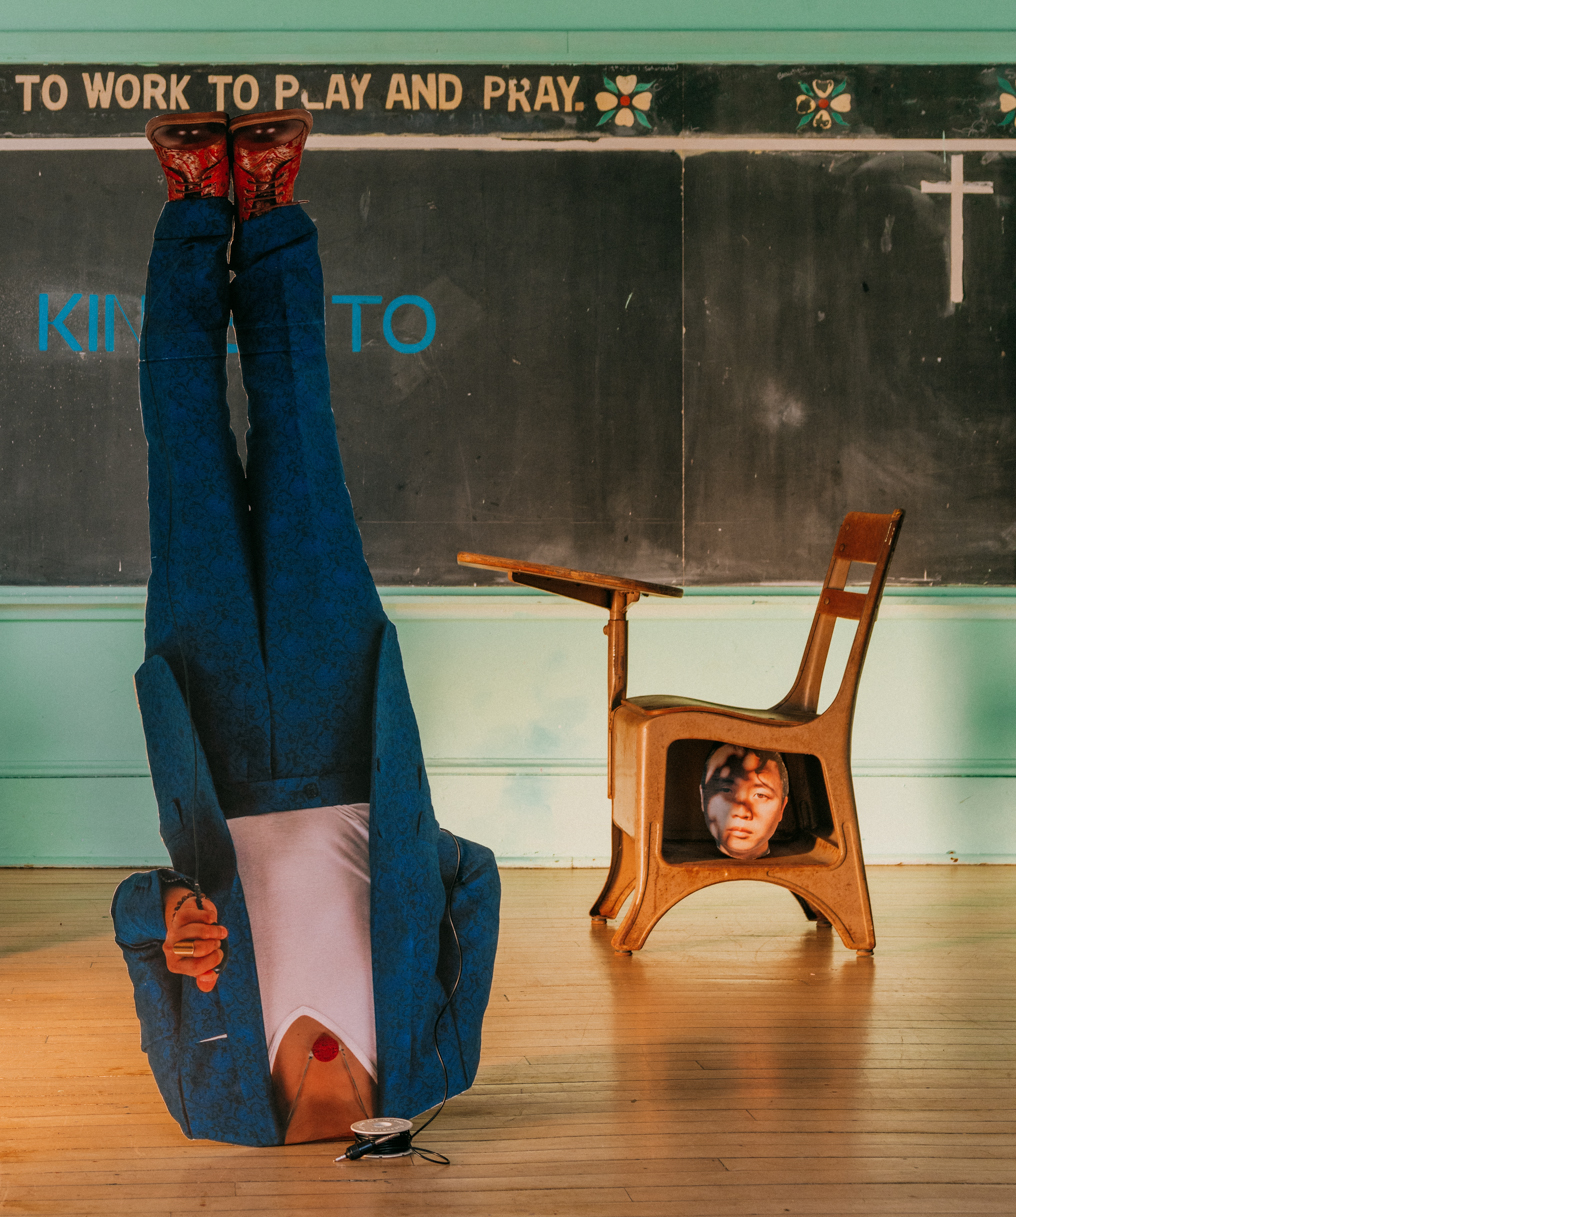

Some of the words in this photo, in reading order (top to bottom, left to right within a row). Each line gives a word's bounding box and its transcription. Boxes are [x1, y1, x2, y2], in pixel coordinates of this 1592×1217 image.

[15, 74, 68, 112] TO
[82, 71, 192, 111] WORK
[208, 74, 259, 112] TO
[274, 72, 372, 111] PLAY
[385, 73, 463, 111] AND
[483, 75, 585, 113] PRAY.
[331, 294, 437, 354] TO
